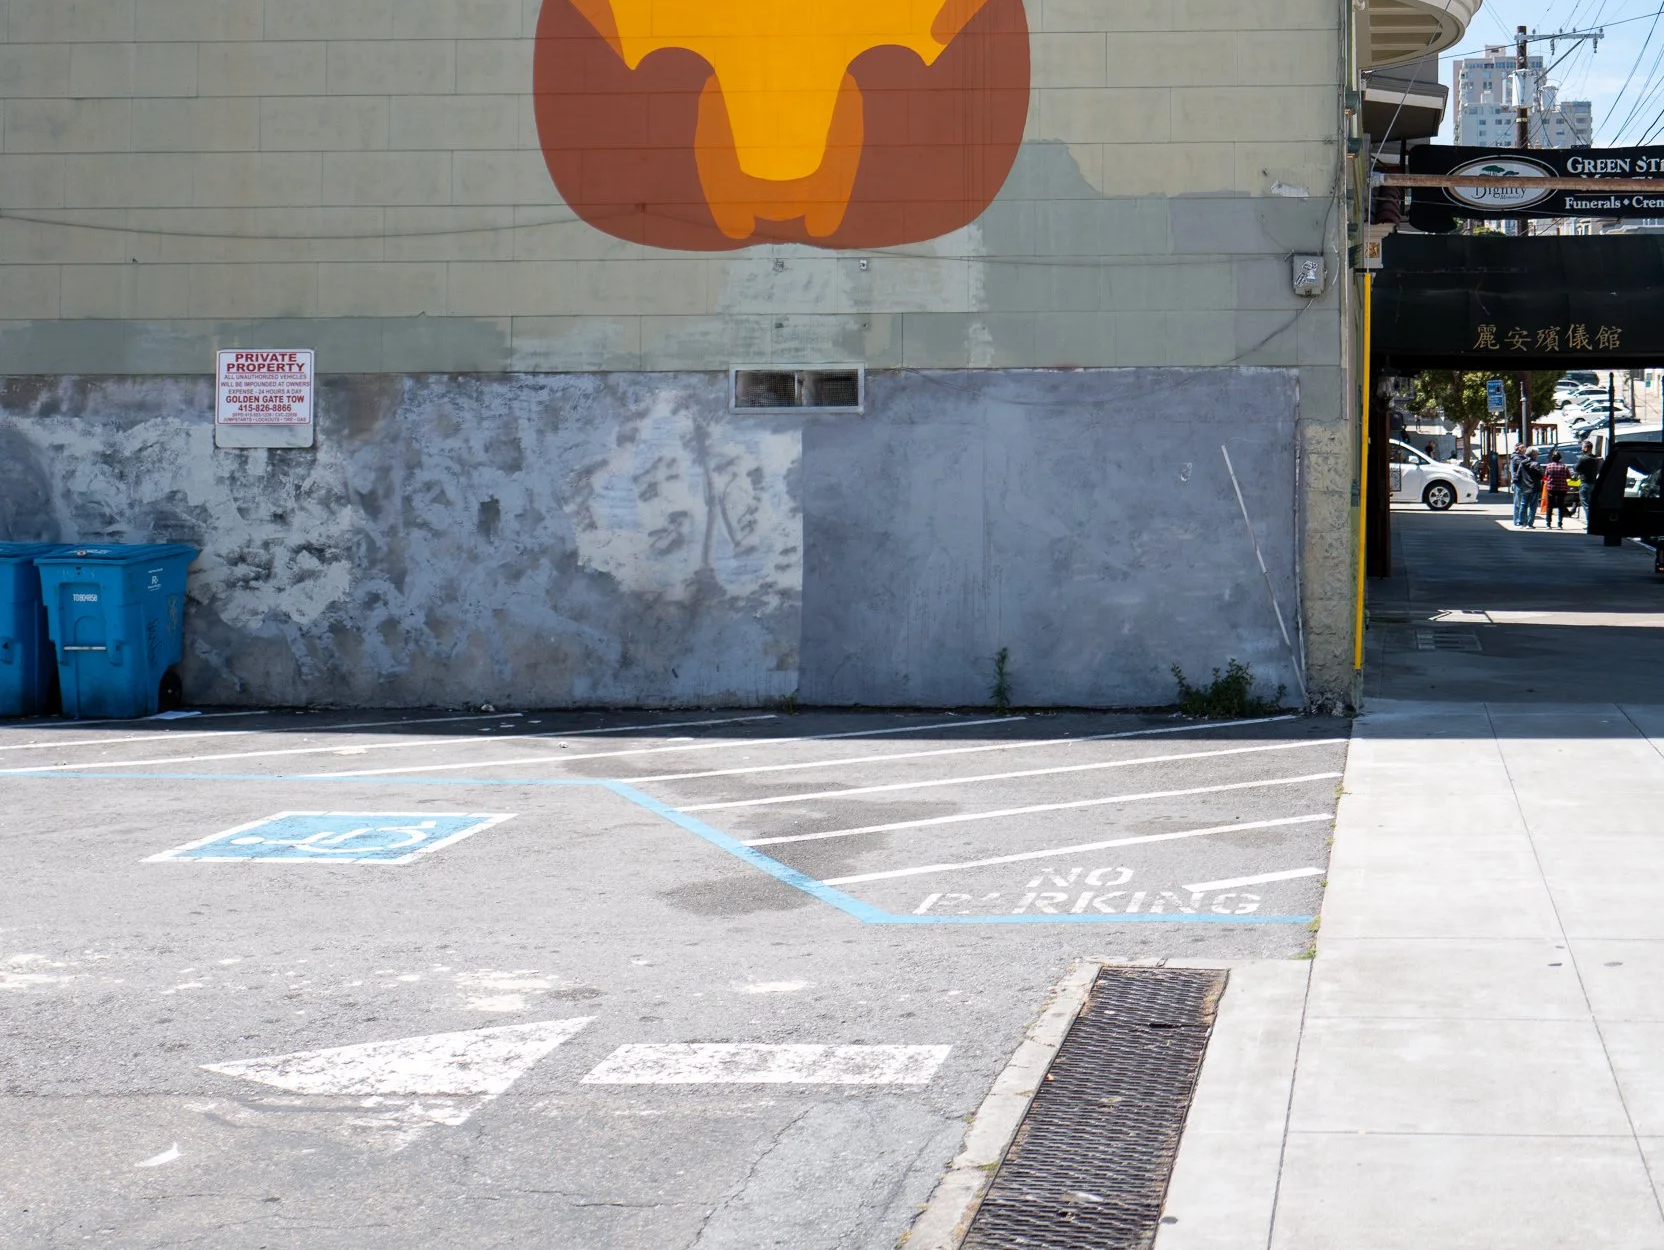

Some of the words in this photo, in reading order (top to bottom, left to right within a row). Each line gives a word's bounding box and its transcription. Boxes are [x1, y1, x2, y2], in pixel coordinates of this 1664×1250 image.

[1566, 156, 1631, 174] GREEN
[1565, 196, 1621, 209] Funerals
[1473, 324, 1623, 351] 麗安殯儀館
[235, 353, 297, 362] PRIVATE
[226, 363, 305, 372] PROPERTY
[225, 395, 260, 403] GOLDEN
[262, 395, 284, 403] GATE
[287, 395, 305, 403] TOW
[238, 404, 292, 412] 415-826-8866
[1026, 867, 1134, 888] NO
